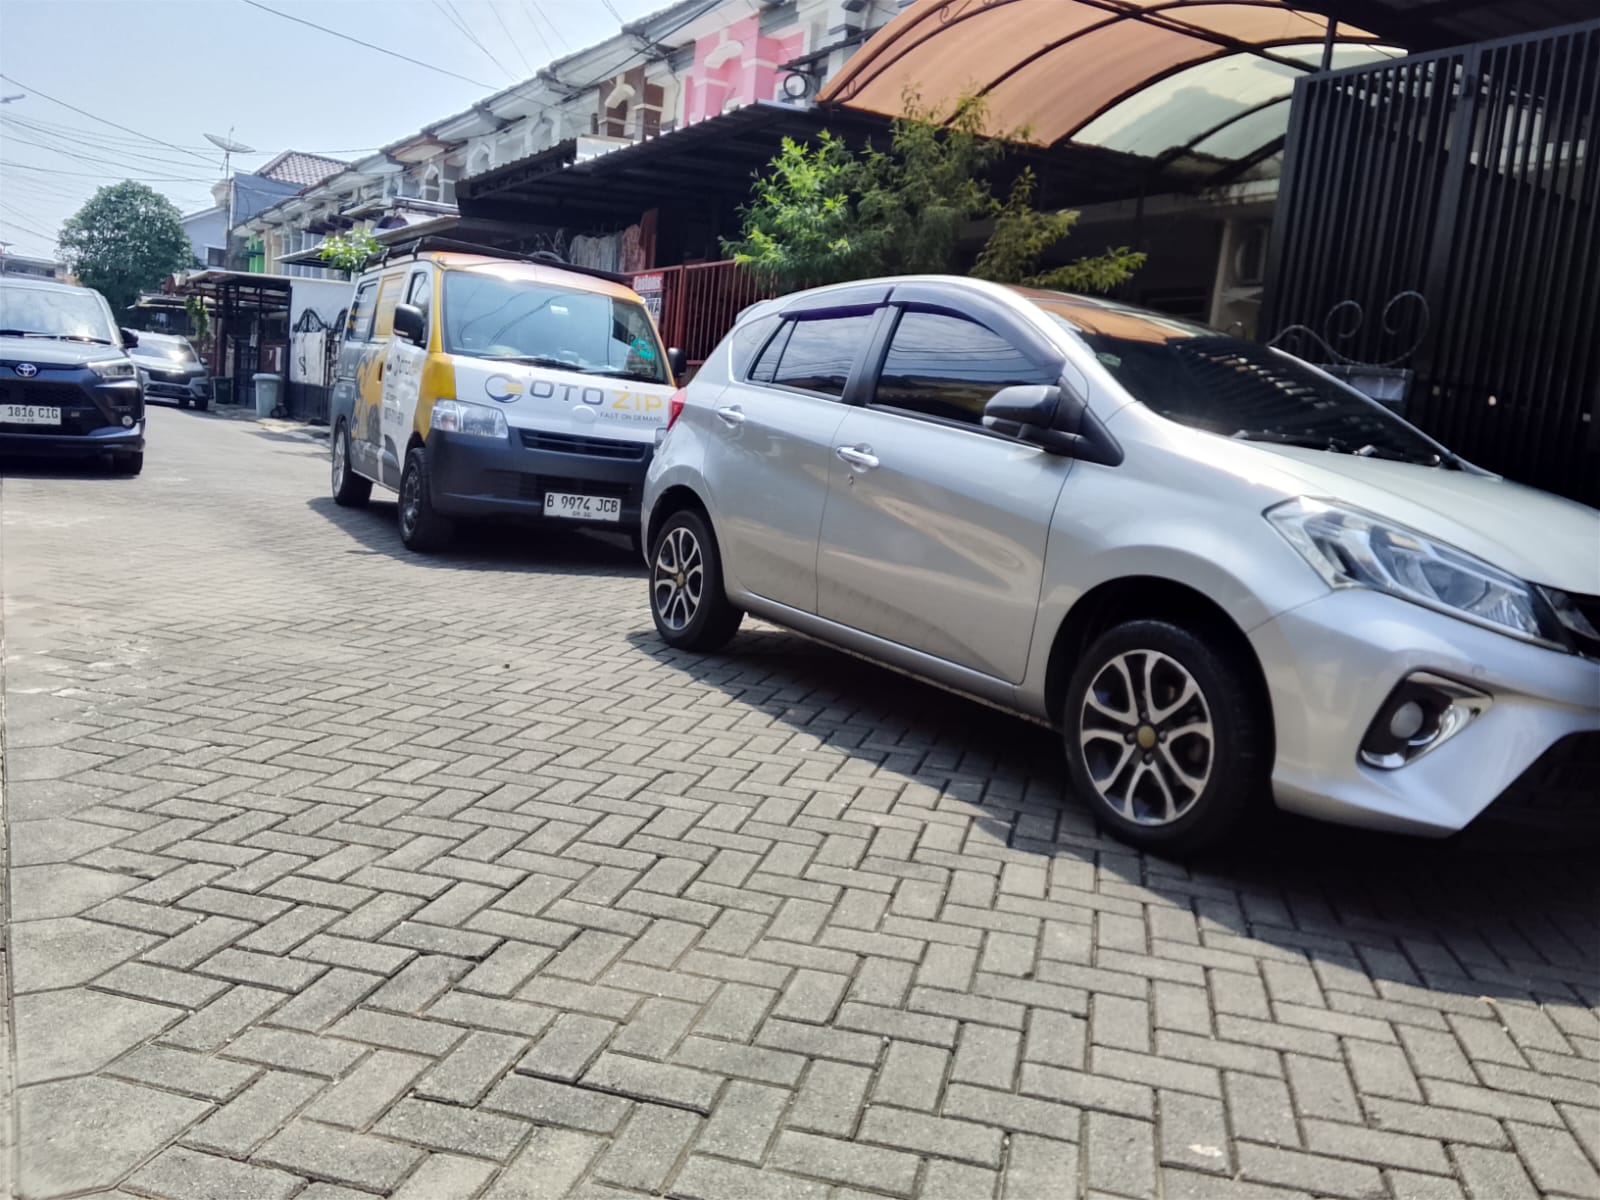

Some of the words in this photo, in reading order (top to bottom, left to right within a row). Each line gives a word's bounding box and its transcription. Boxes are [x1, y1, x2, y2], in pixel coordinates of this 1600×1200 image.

[8, 406, 34, 417] 1816
[38, 407, 58, 419] CIG
[600, 412, 618, 420] FAST
[621, 413, 631, 421] ON
[632, 414, 663, 423] DEMAND
[546, 494, 554, 507] B
[561, 495, 591, 511] 9974
[596, 498, 618, 513] JCB
